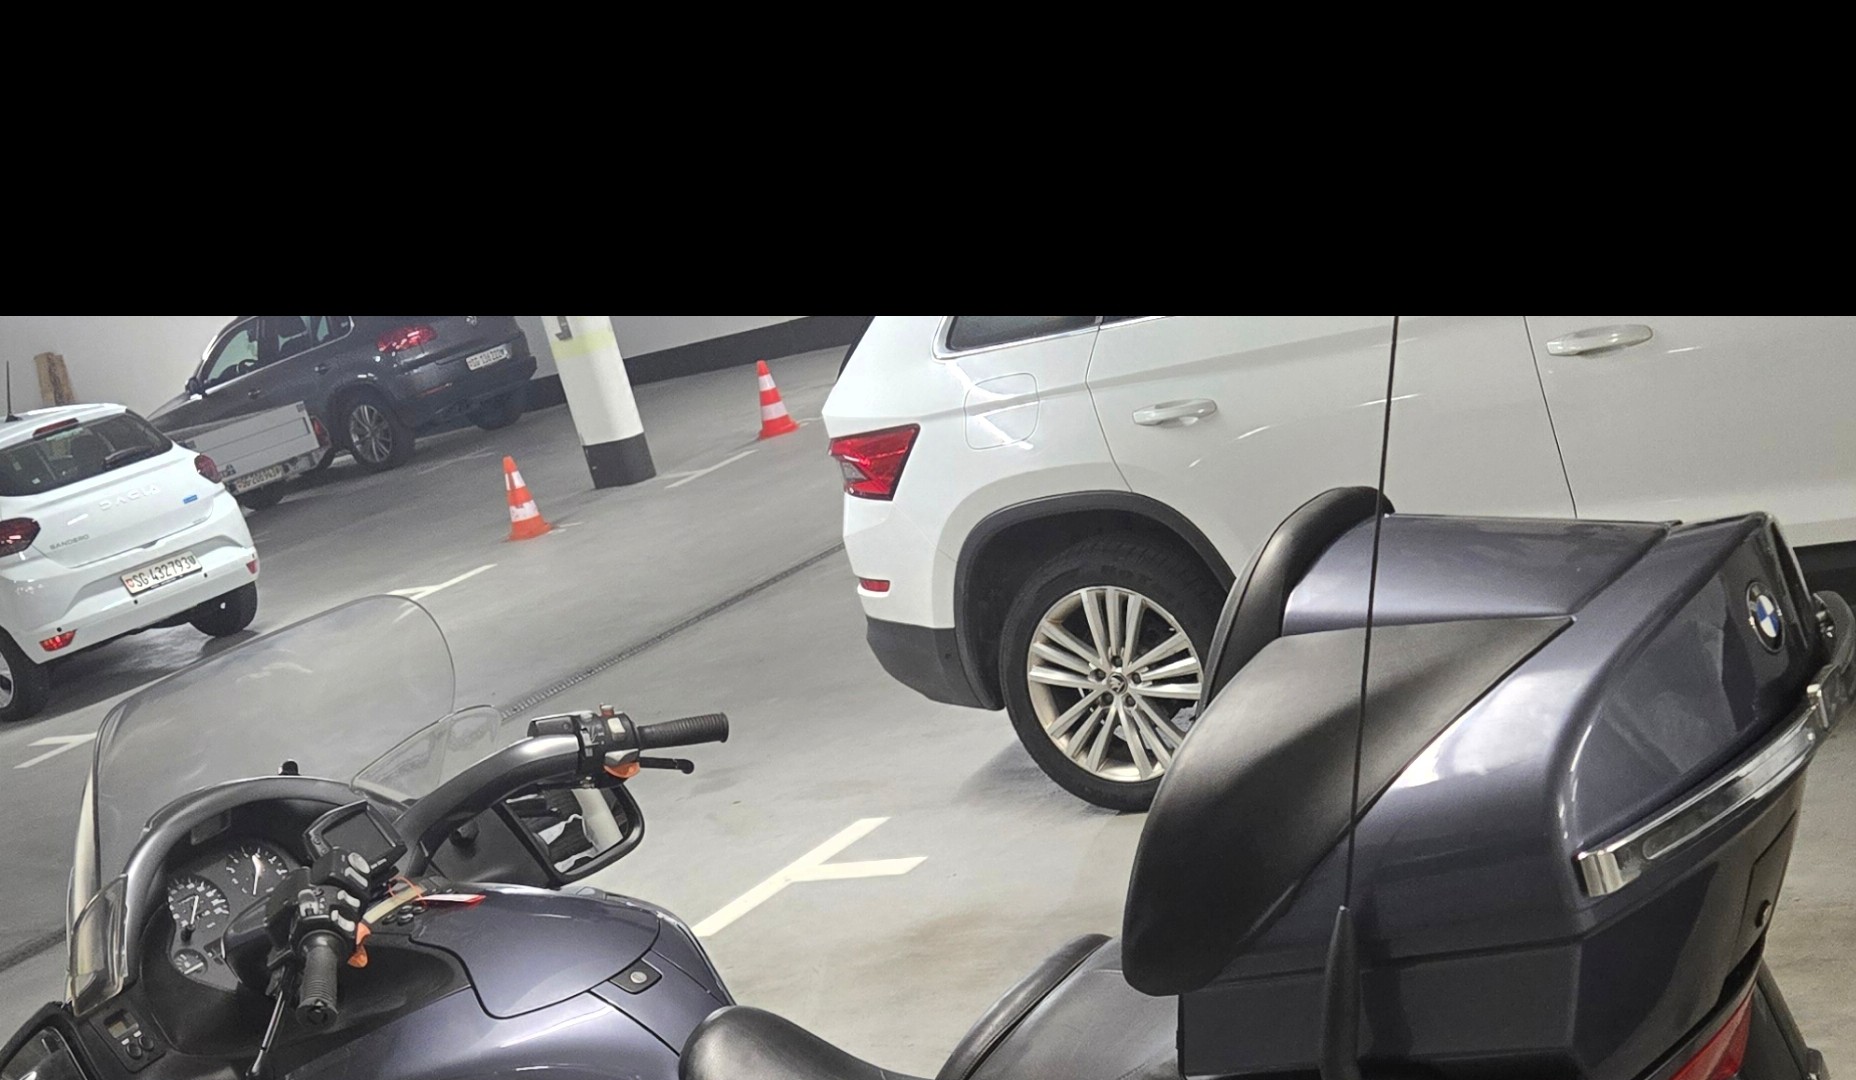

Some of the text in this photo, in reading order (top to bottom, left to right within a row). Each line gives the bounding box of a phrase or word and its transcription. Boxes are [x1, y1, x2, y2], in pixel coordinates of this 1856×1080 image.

[50, 534, 90, 550] SANDERO
[132, 572, 149, 588] SG
[149, 557, 192, 580] 432793
